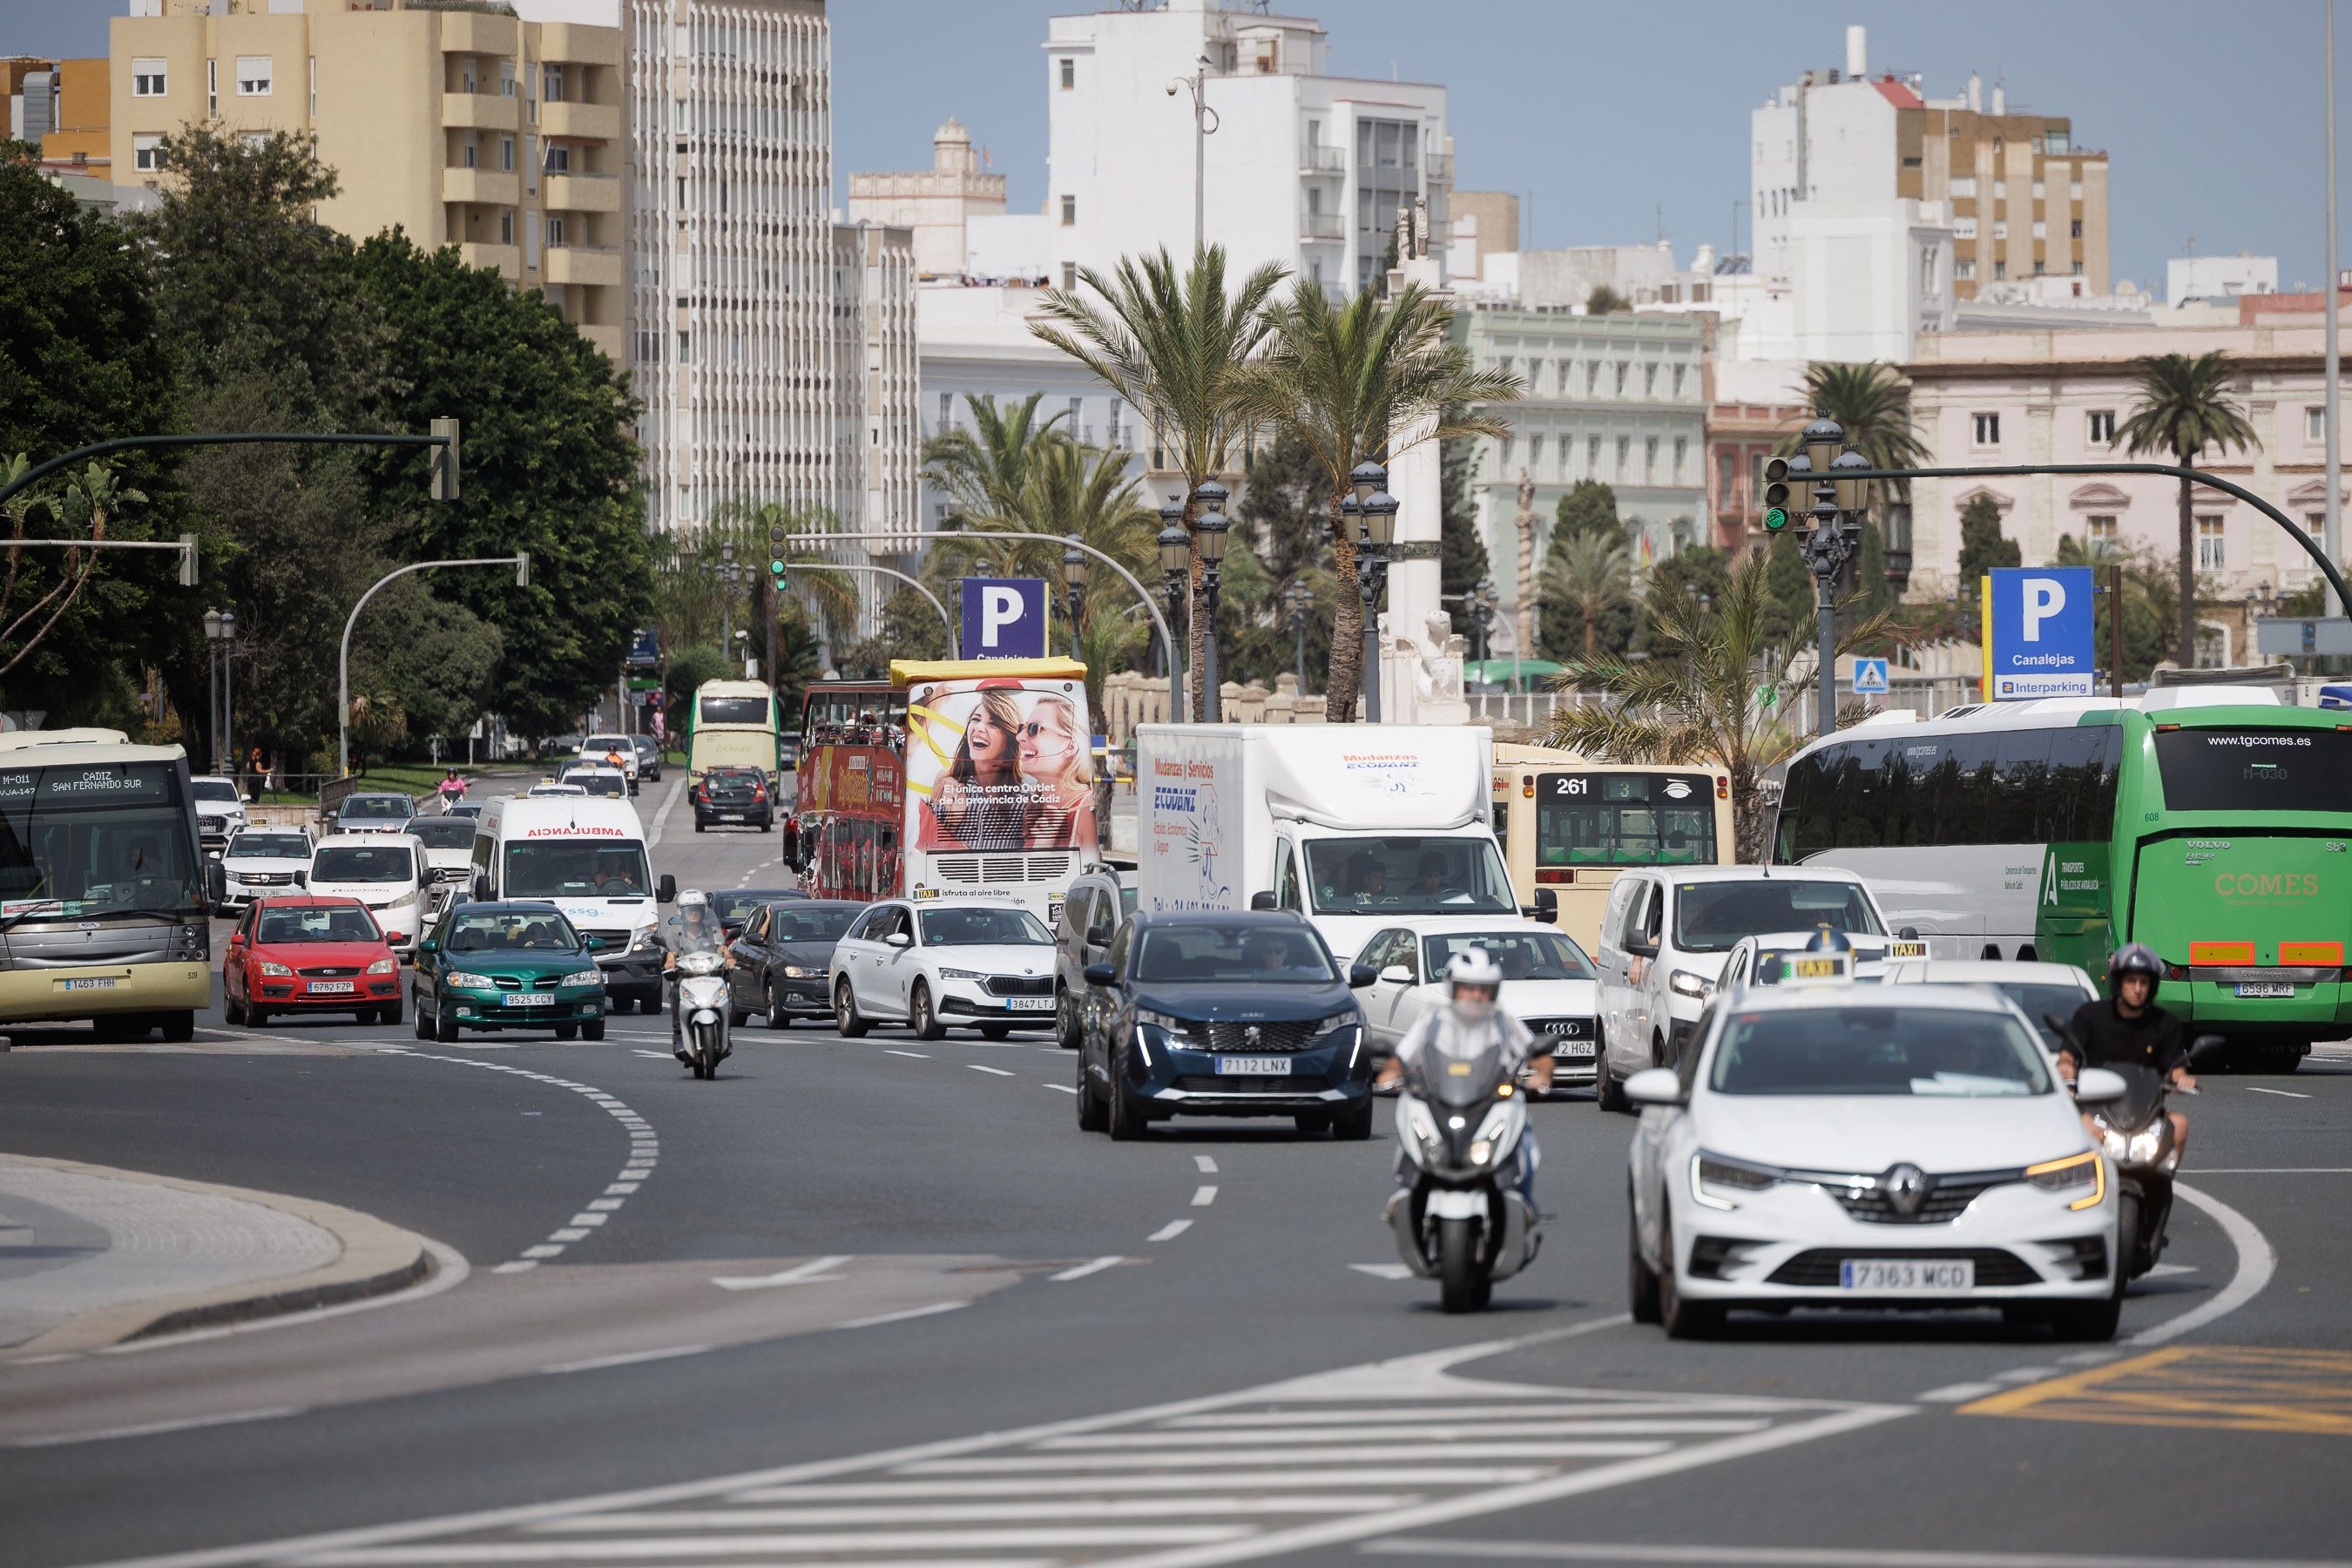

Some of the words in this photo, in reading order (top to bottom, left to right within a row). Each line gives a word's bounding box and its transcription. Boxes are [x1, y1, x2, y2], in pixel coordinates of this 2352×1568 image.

[982, 585, 1024, 647] P
[2022, 578, 2066, 642] P
[2012, 653, 2075, 667] Canalejas
[2016, 681, 2087, 694] Interparking
[2207, 735, 2312, 747] www.tgcomes.es
[1343, 754, 1418, 762] Mudanzas
[1154, 758, 1183, 778] Mudanzas
[1183, 764, 1187, 781] y
[1188, 759, 1213, 779] Servicios
[2243, 768, 2288, 780] M-030
[3, 774, 30, 784] M-011
[83, 771, 112, 781] CADIZ
[73, 781, 121, 790] FERNANDO
[124, 780, 142, 788] SUR
[943, 785, 954, 794] El
[956, 783, 984, 794] único
[985, 785, 1020, 794] centro
[1021, 783, 1057, 793] Outlet
[1493, 777, 1504, 792] 261
[1556, 778, 1588, 795] 261
[1619, 781, 1630, 798] 3
[939, 795, 953, 805] de
[954, 795, 965, 805] la
[966, 794, 1015, 806] provincia
[1016, 794, 1030, 803] de
[1031, 793, 1061, 804] Cádiz
[1154, 786, 1197, 813] ECODANI
[2144, 813, 2159, 822] 608
[2185, 841, 2231, 849] VOLVO
[2077, 880, 2081, 890] DE
[2215, 873, 2319, 896] COMES
[919, 889, 935, 898] TAXI
[1892, 943, 1917, 956] TAXI
[1796, 959, 1835, 977] TAXI
[187, 971, 198, 980] 539
[73, 980, 94, 989] 1463
[314, 983, 334, 992] 6782
[336, 982, 352, 991] FZP
[2241, 984, 2269, 994] 6596
[2271, 983, 2292, 993] MRF
[509, 996, 532, 1004] 9525
[534, 995, 551, 1004] CCY
[1012, 1000, 1035, 1009] 3847
[1037, 1000, 1054, 1009] LTJ
[1571, 1043, 1592, 1054] HGZ
[1224, 1059, 1258, 1072] 7112
[1261, 1058, 1288, 1072] LNX
[1857, 1265, 1915, 1287] 7363
